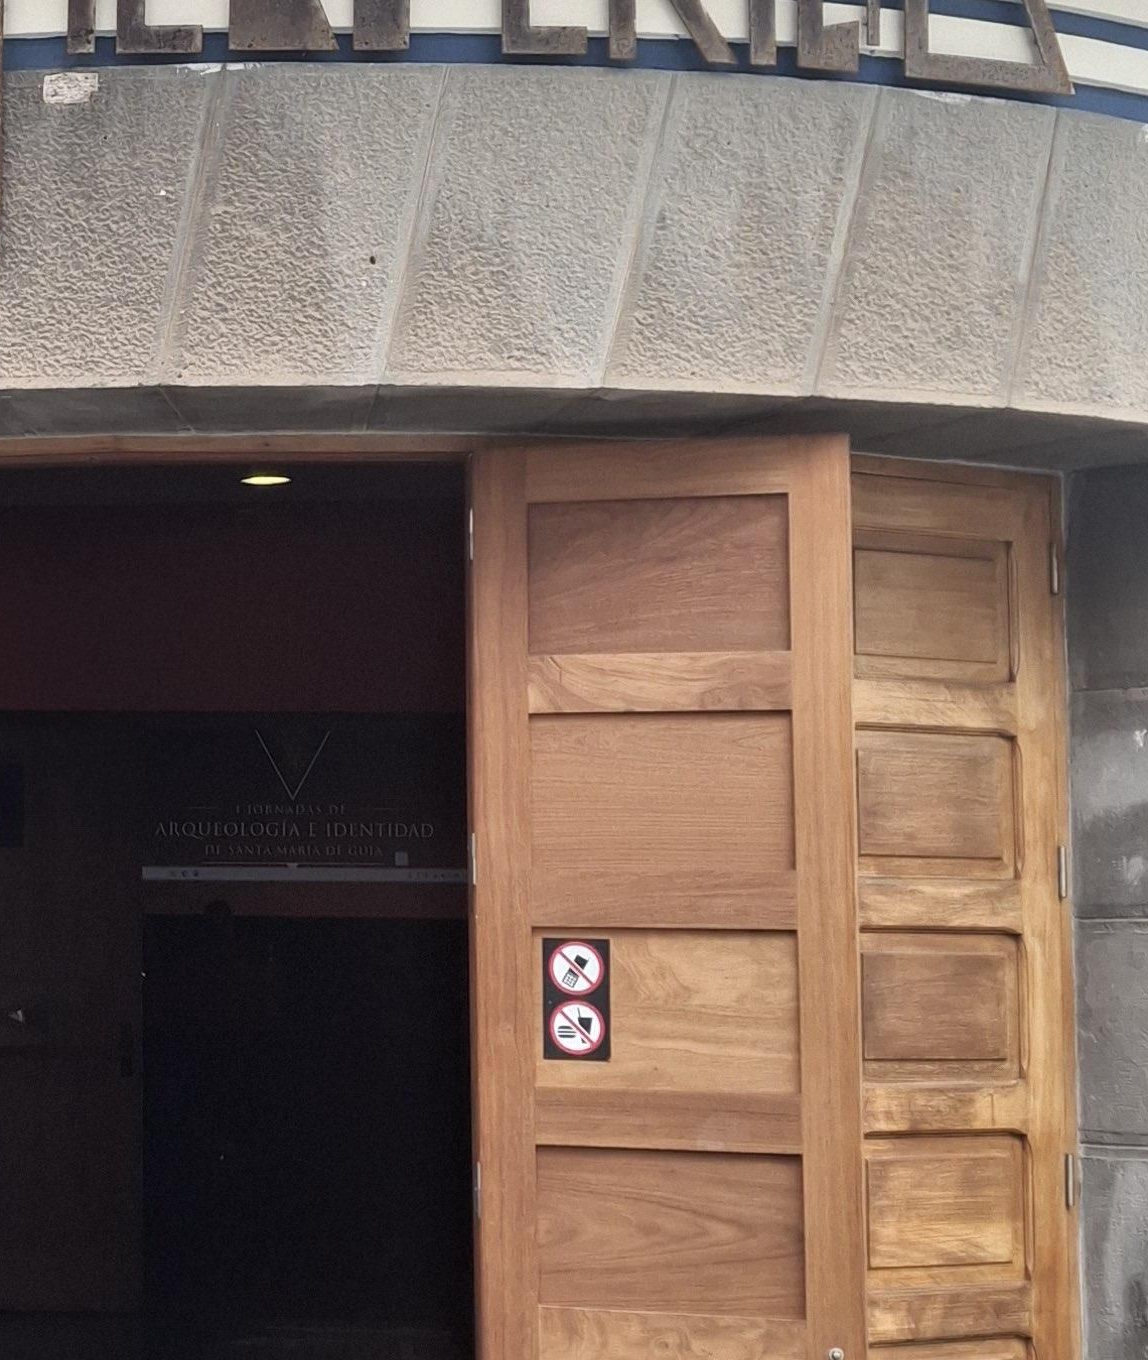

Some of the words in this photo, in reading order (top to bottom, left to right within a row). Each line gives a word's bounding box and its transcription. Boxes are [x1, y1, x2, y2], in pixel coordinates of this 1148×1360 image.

[247, 804, 322, 816] JORNADAS
[328, 804, 346, 816] DE
[155, 818, 301, 840] ARQUEOLOGÍA
[308, 821, 318, 838] E
[326, 822, 436, 839] IDENTIDAD
[204, 844, 221, 856] DE
[228, 844, 273, 857] SANTA
[325, 845, 341, 857] DE
